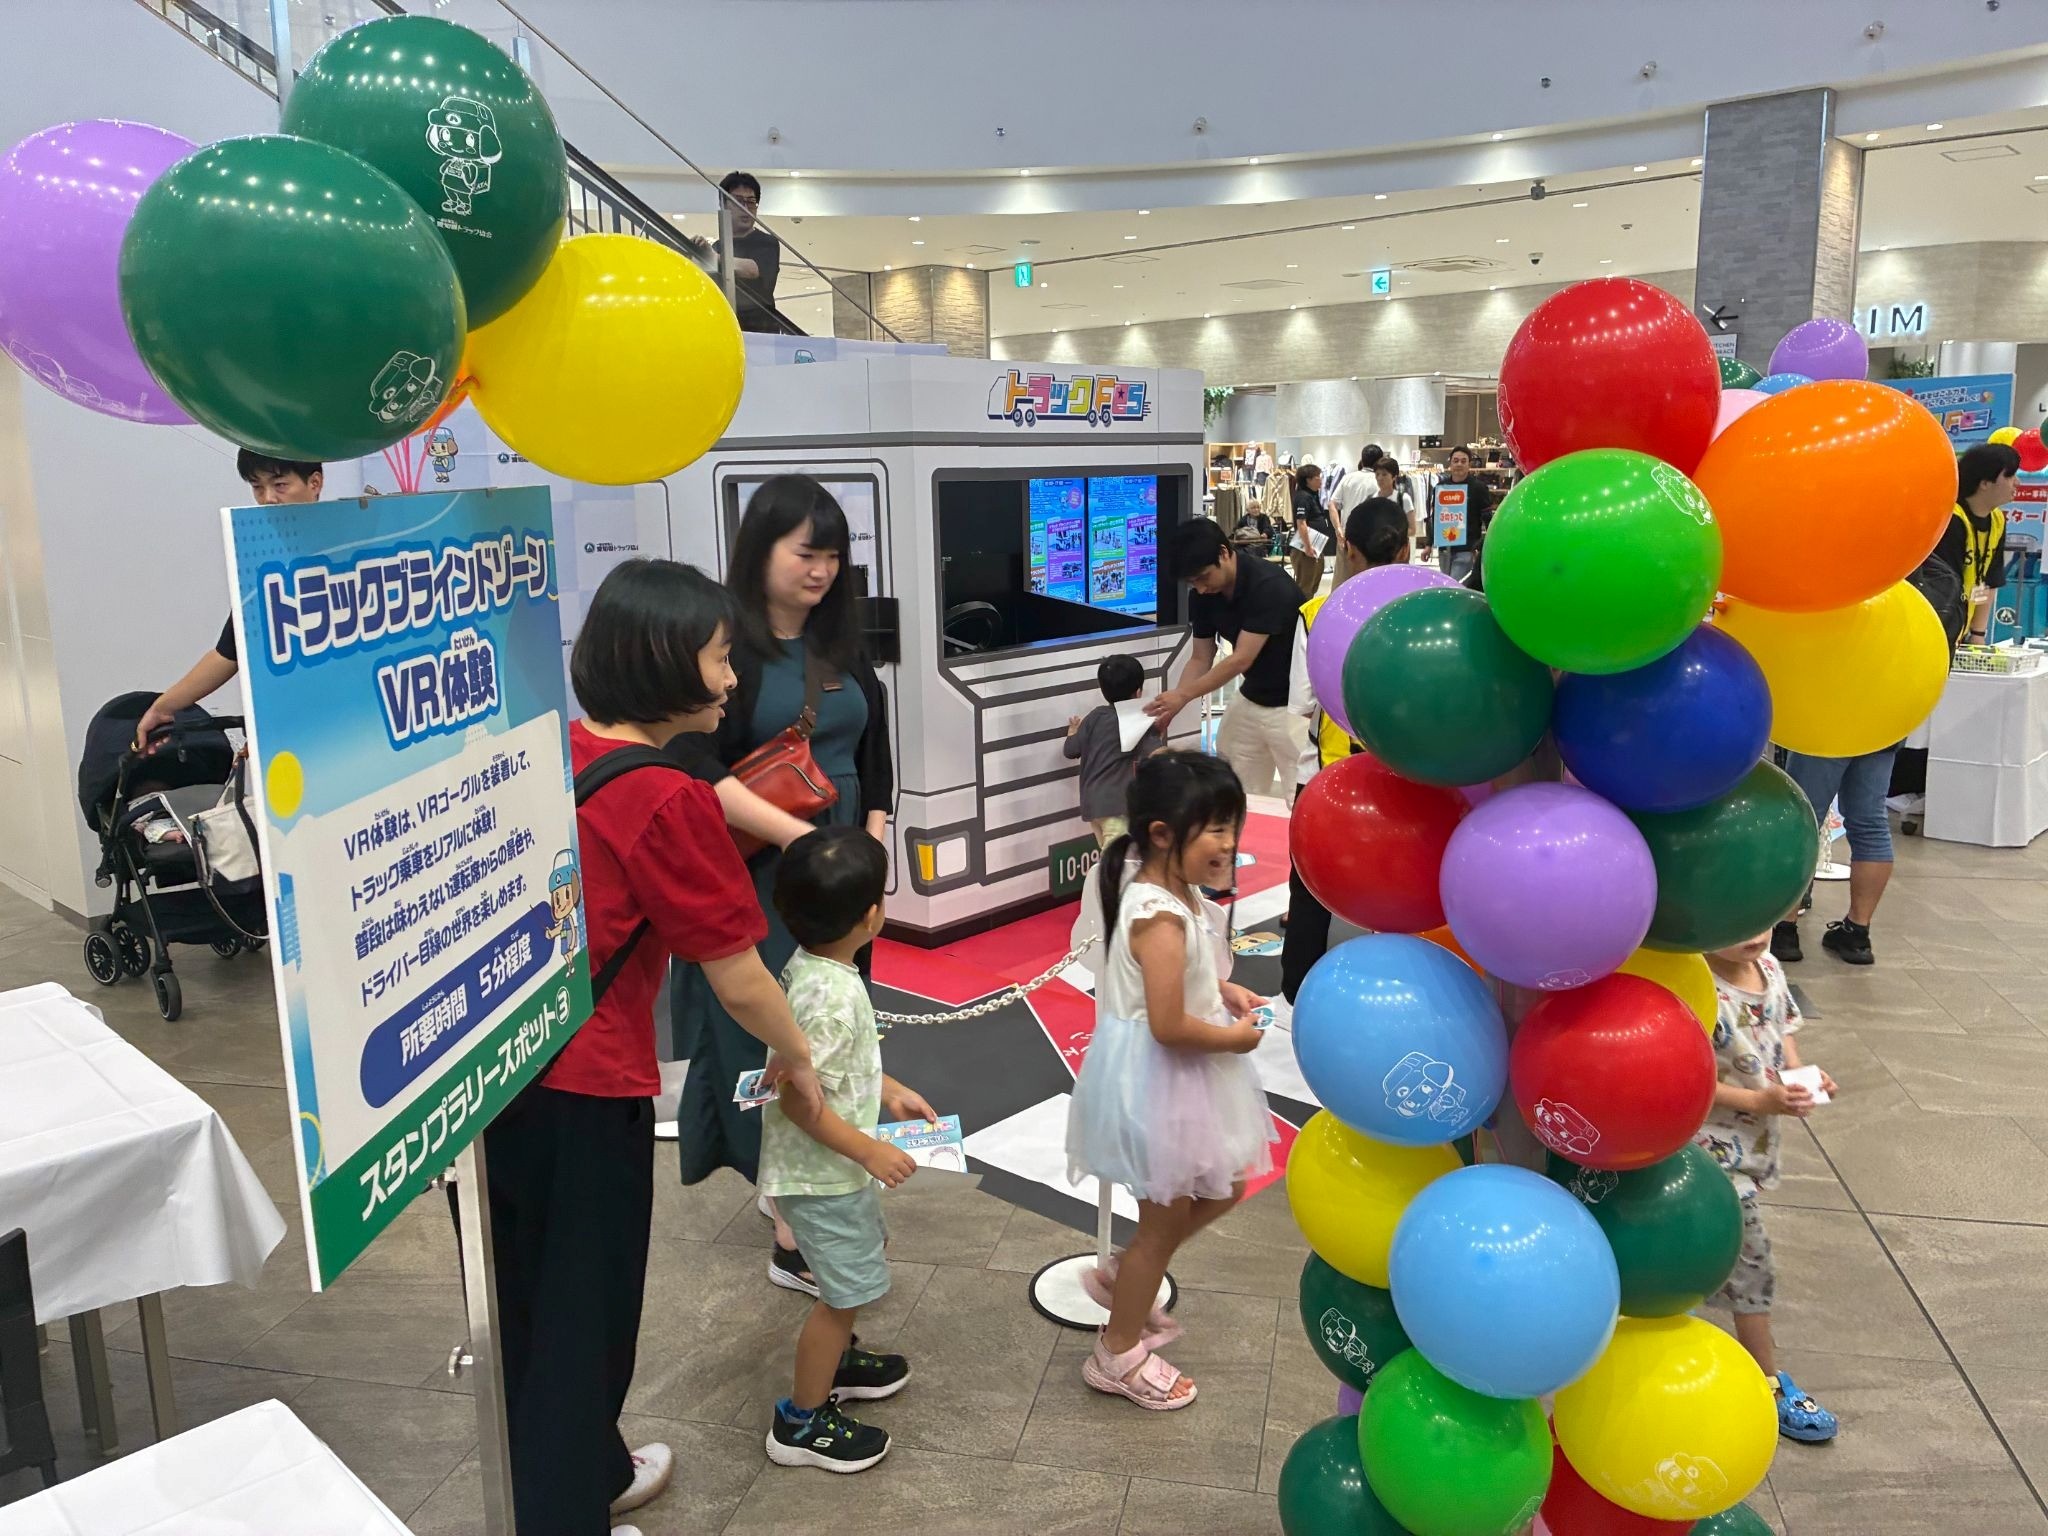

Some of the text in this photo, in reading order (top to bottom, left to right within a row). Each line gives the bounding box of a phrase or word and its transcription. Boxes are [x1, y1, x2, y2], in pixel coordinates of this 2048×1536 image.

[1853, 305, 1922, 334] IM
[1004, 369, 1146, 417] トラックFes
[267, 535, 547, 657] トラックブラインドゾーン
[453, 633, 475, 650] たいけん
[381, 645, 496, 733] VR体験
[343, 750, 531, 861] VR体験は、VRゴーグルを装着して、
[351, 806, 497, 912] トラック乗車をリアルに体験！
[355, 828, 535, 961] 普段は味わえない運転席からの景色や、
[361, 874, 527, 1007] ドライバー目線の世界を楽しめます。
[479, 931, 532, 998] 5分程度
[400, 983, 468, 1067] 所要時間
